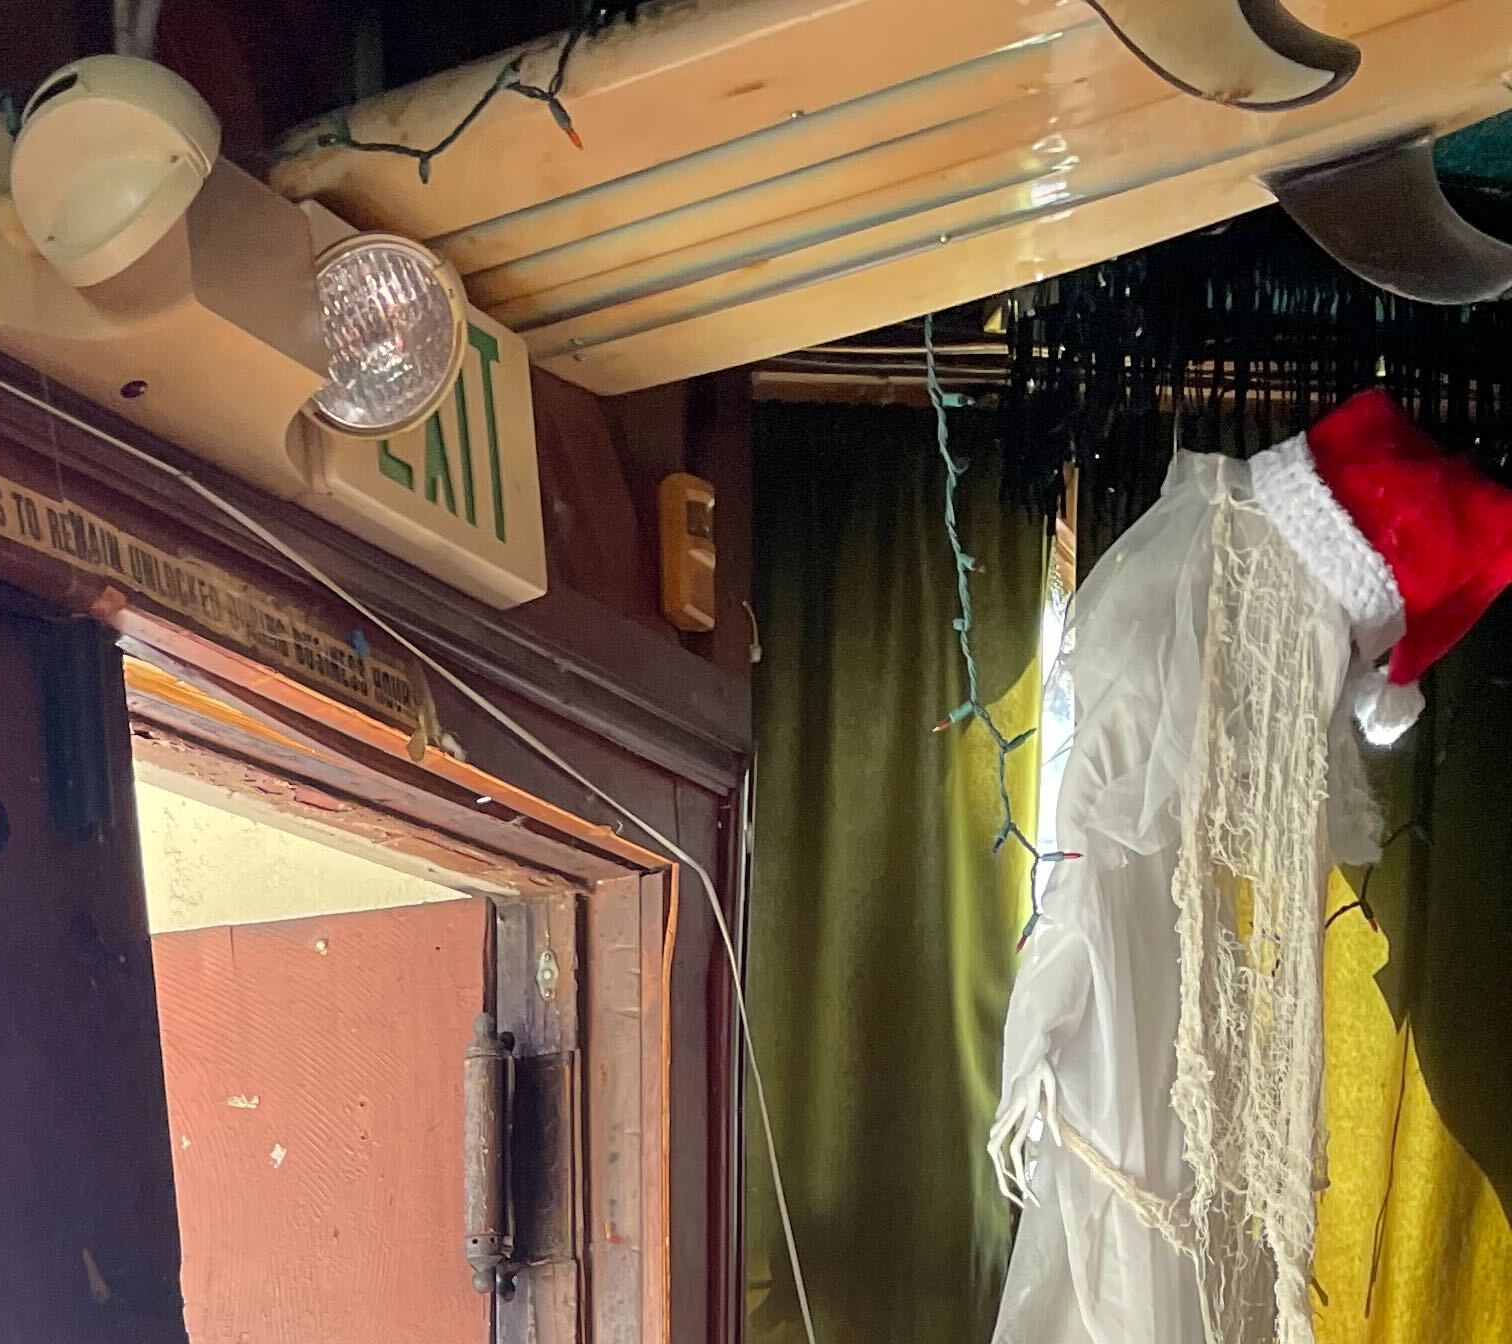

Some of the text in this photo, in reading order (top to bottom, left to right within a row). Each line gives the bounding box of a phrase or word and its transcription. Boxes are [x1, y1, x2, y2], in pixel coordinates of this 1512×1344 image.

[11, 492, 41, 541] TO
[47, 508, 124, 574] REMAIN
[128, 544, 222, 622] UNLOCKED
